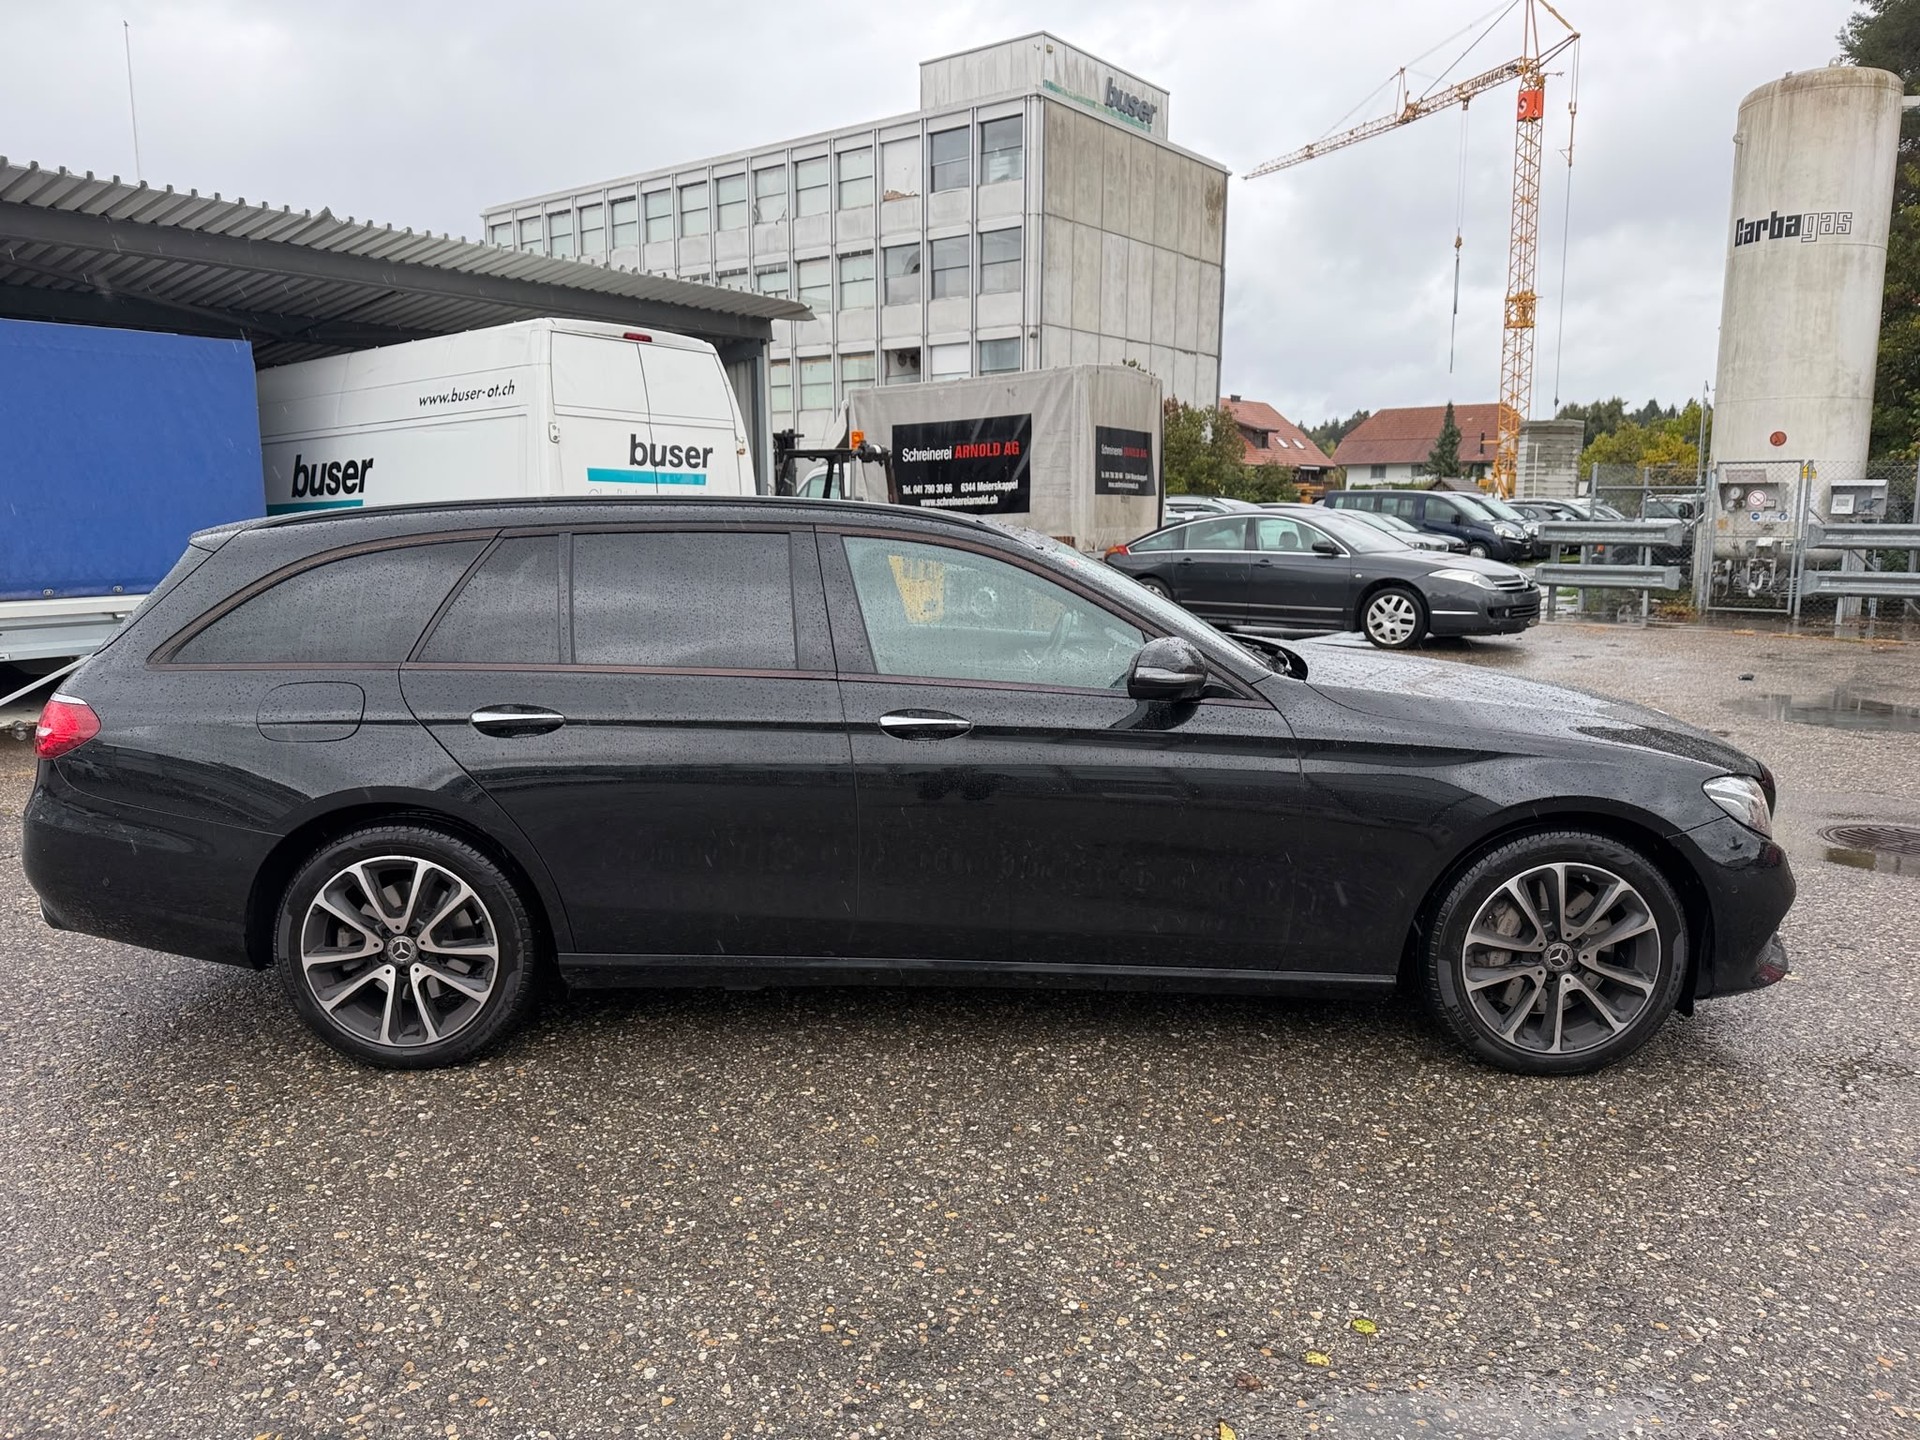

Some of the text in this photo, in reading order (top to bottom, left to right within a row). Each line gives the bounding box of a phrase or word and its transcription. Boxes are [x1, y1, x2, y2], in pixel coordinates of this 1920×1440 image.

[1104, 77, 1157, 124] buser
[1734, 210, 1853, 247] Carbagas
[419, 379, 515, 407] www.buser-ot.ch
[629, 433, 714, 469] buser
[902, 440, 1020, 462] Schreinerei ARNOLD AG
[291, 454, 374, 498] buser
[902, 480, 1019, 495] Tel. 041 790 30 66 6344 Meierskappel
